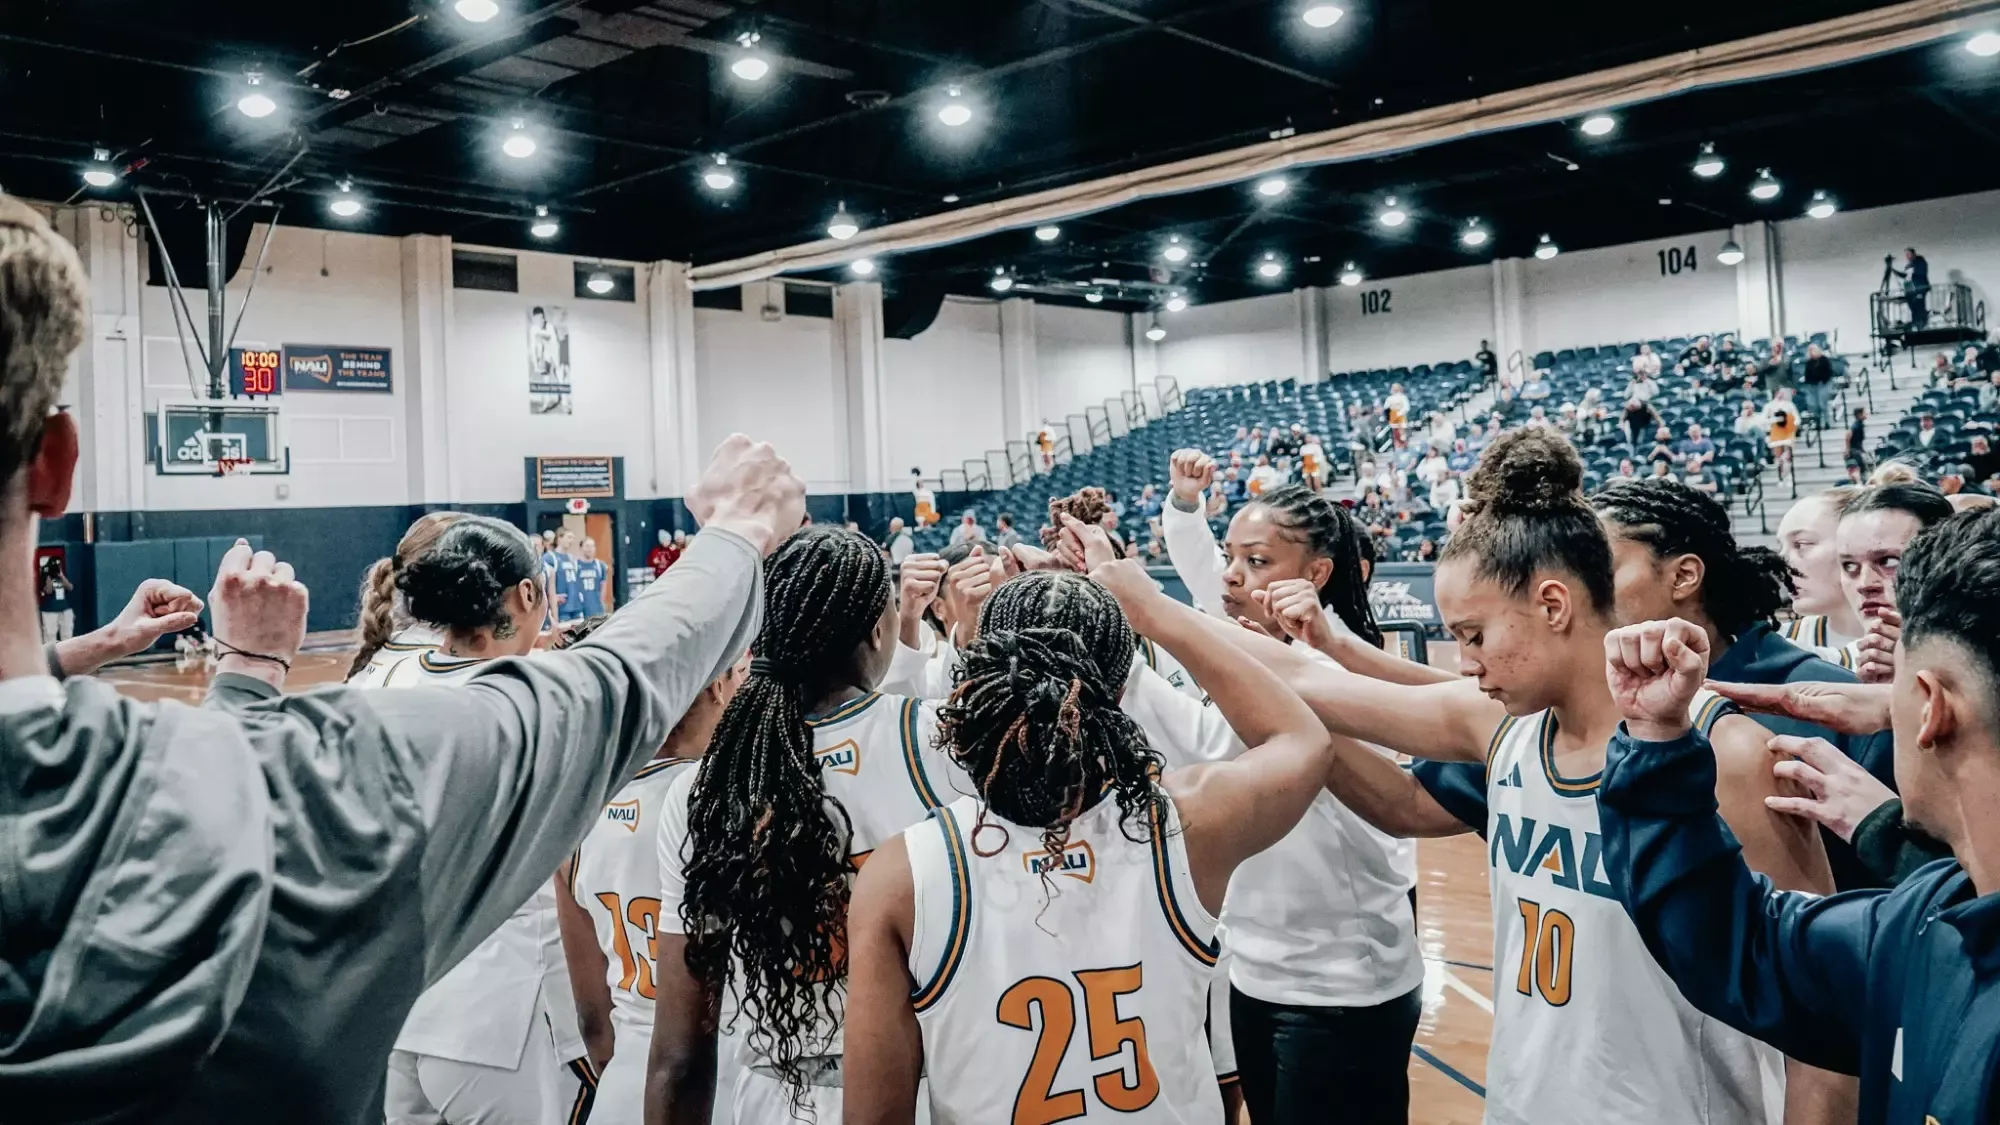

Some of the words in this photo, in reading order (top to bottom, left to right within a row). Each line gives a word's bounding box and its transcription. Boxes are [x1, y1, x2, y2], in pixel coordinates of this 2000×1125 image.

[1657, 245, 1697, 277] 104
[1360, 288, 1392, 316] 102
[241, 351, 278, 367] 10:00
[294, 359, 328, 374] NAU
[342, 360, 381, 370] BEHIND
[244, 367, 272, 391] 30
[177, 443, 240, 460] adas
[815, 750, 853, 768] AU
[607, 807, 635, 821] NAU
[595, 891, 662, 1000] 13
[1517, 897, 1575, 1007] 10
[997, 961, 1160, 1125] 25
